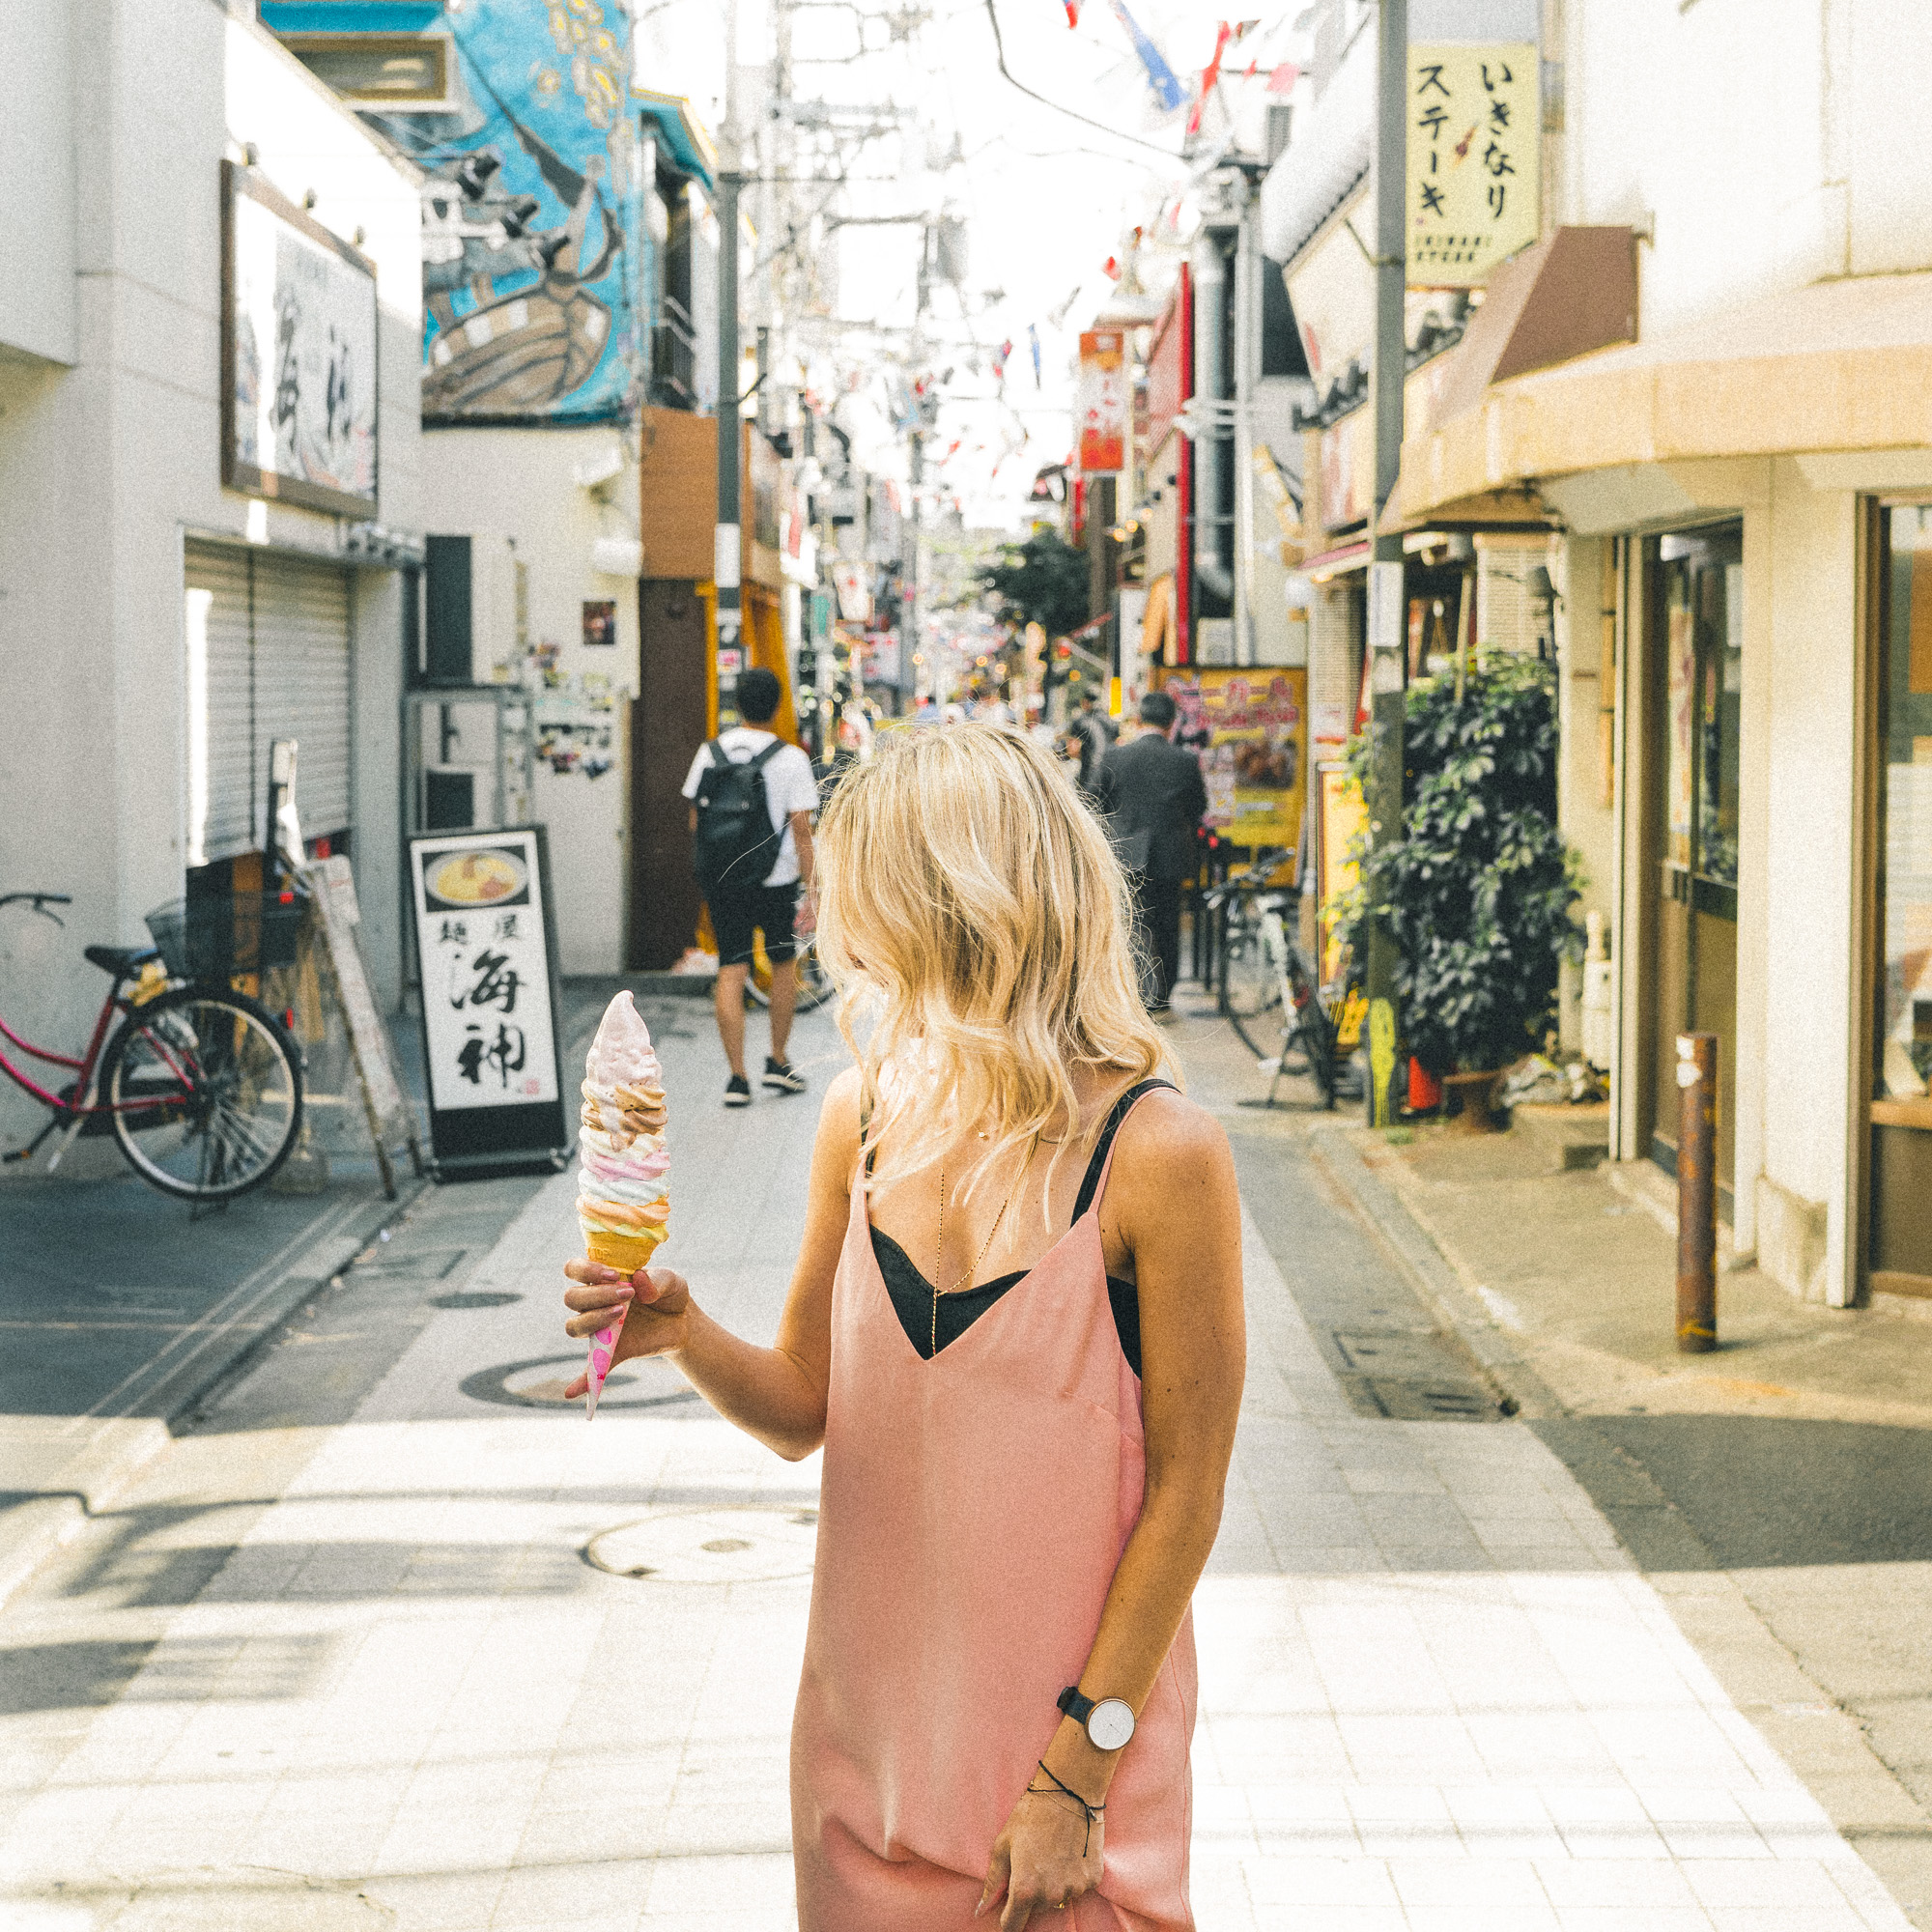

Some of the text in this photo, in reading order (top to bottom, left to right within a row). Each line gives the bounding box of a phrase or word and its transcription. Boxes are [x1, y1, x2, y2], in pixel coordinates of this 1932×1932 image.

[1417, 64, 1450, 216] ステーキ
[1481, 63, 1516, 218] いきなり
